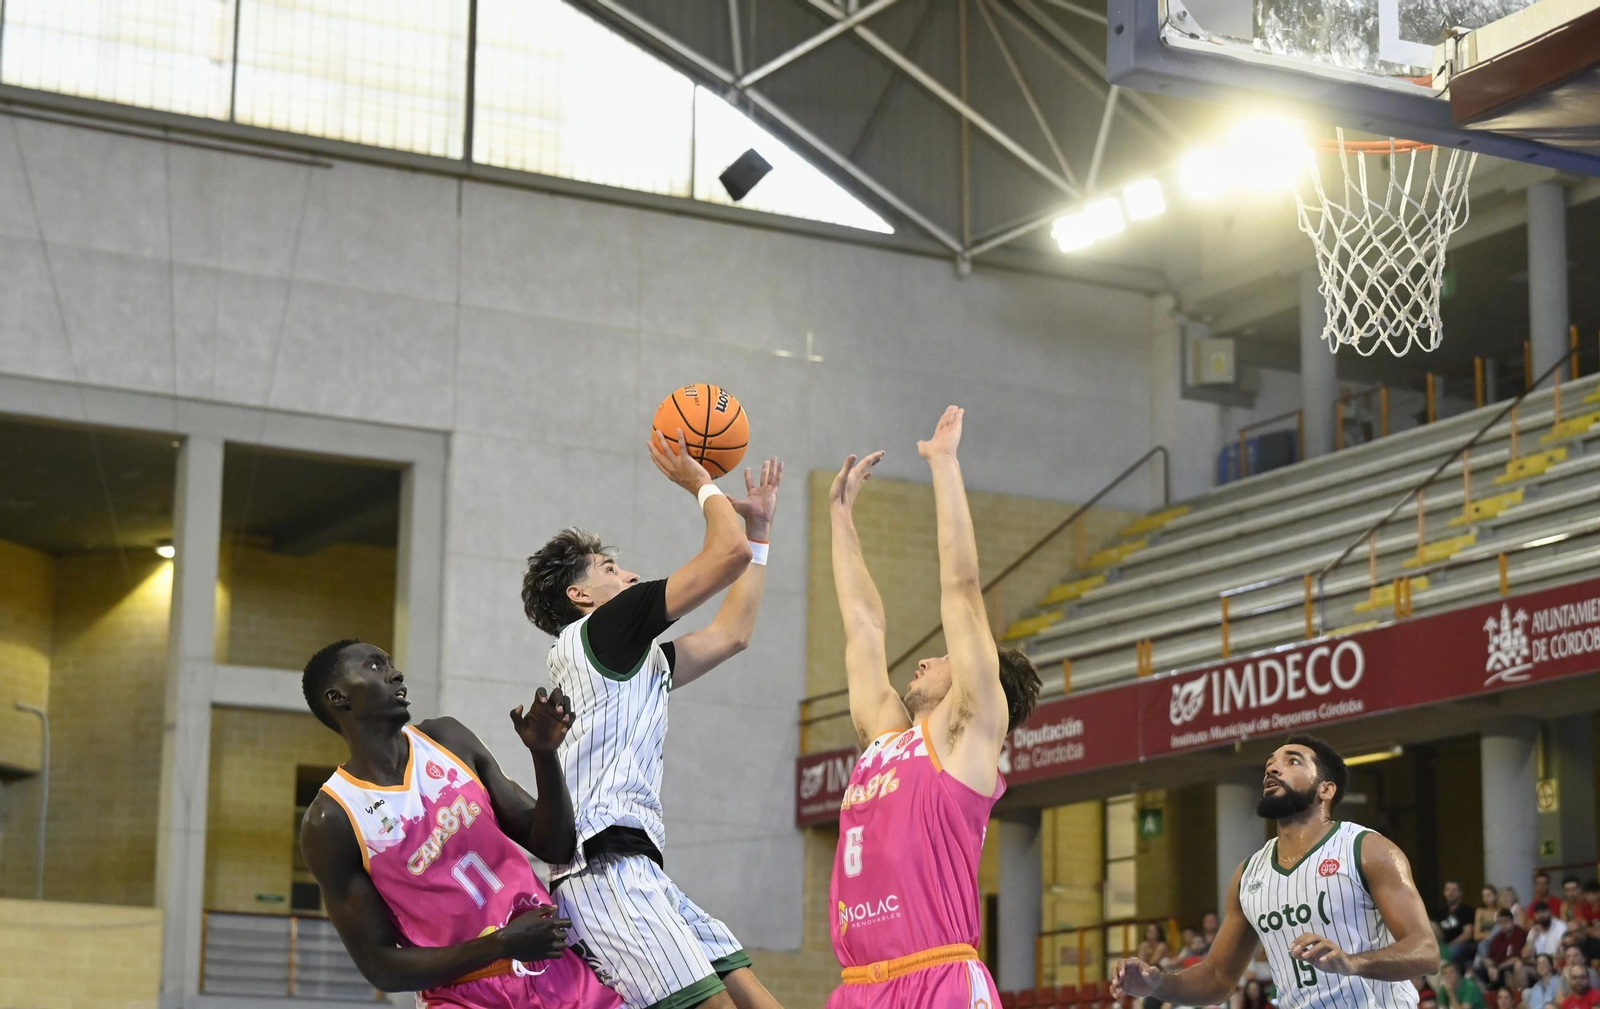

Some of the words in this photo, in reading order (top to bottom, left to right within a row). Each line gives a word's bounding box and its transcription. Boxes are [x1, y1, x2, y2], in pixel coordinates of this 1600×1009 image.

[1532, 637, 1549, 663] DE
[1550, 629, 1600, 660] CÓRDOB
[1211, 640, 1365, 716] IMDECO
[1013, 717, 1084, 750] Diputación
[1170, 731, 1209, 749] Instituto
[1209, 717, 1256, 741] Municipal
[1256, 716, 1270, 731] de
[1271, 708, 1318, 730] Deportes
[1318, 698, 1364, 719] Córdoba
[1013, 752, 1031, 772] de
[1031, 742, 1085, 768] Córdoba
[843, 825, 864, 878] 6
[851, 912, 902, 929] RENOVABLES
[1288, 947, 1318, 989] 15
